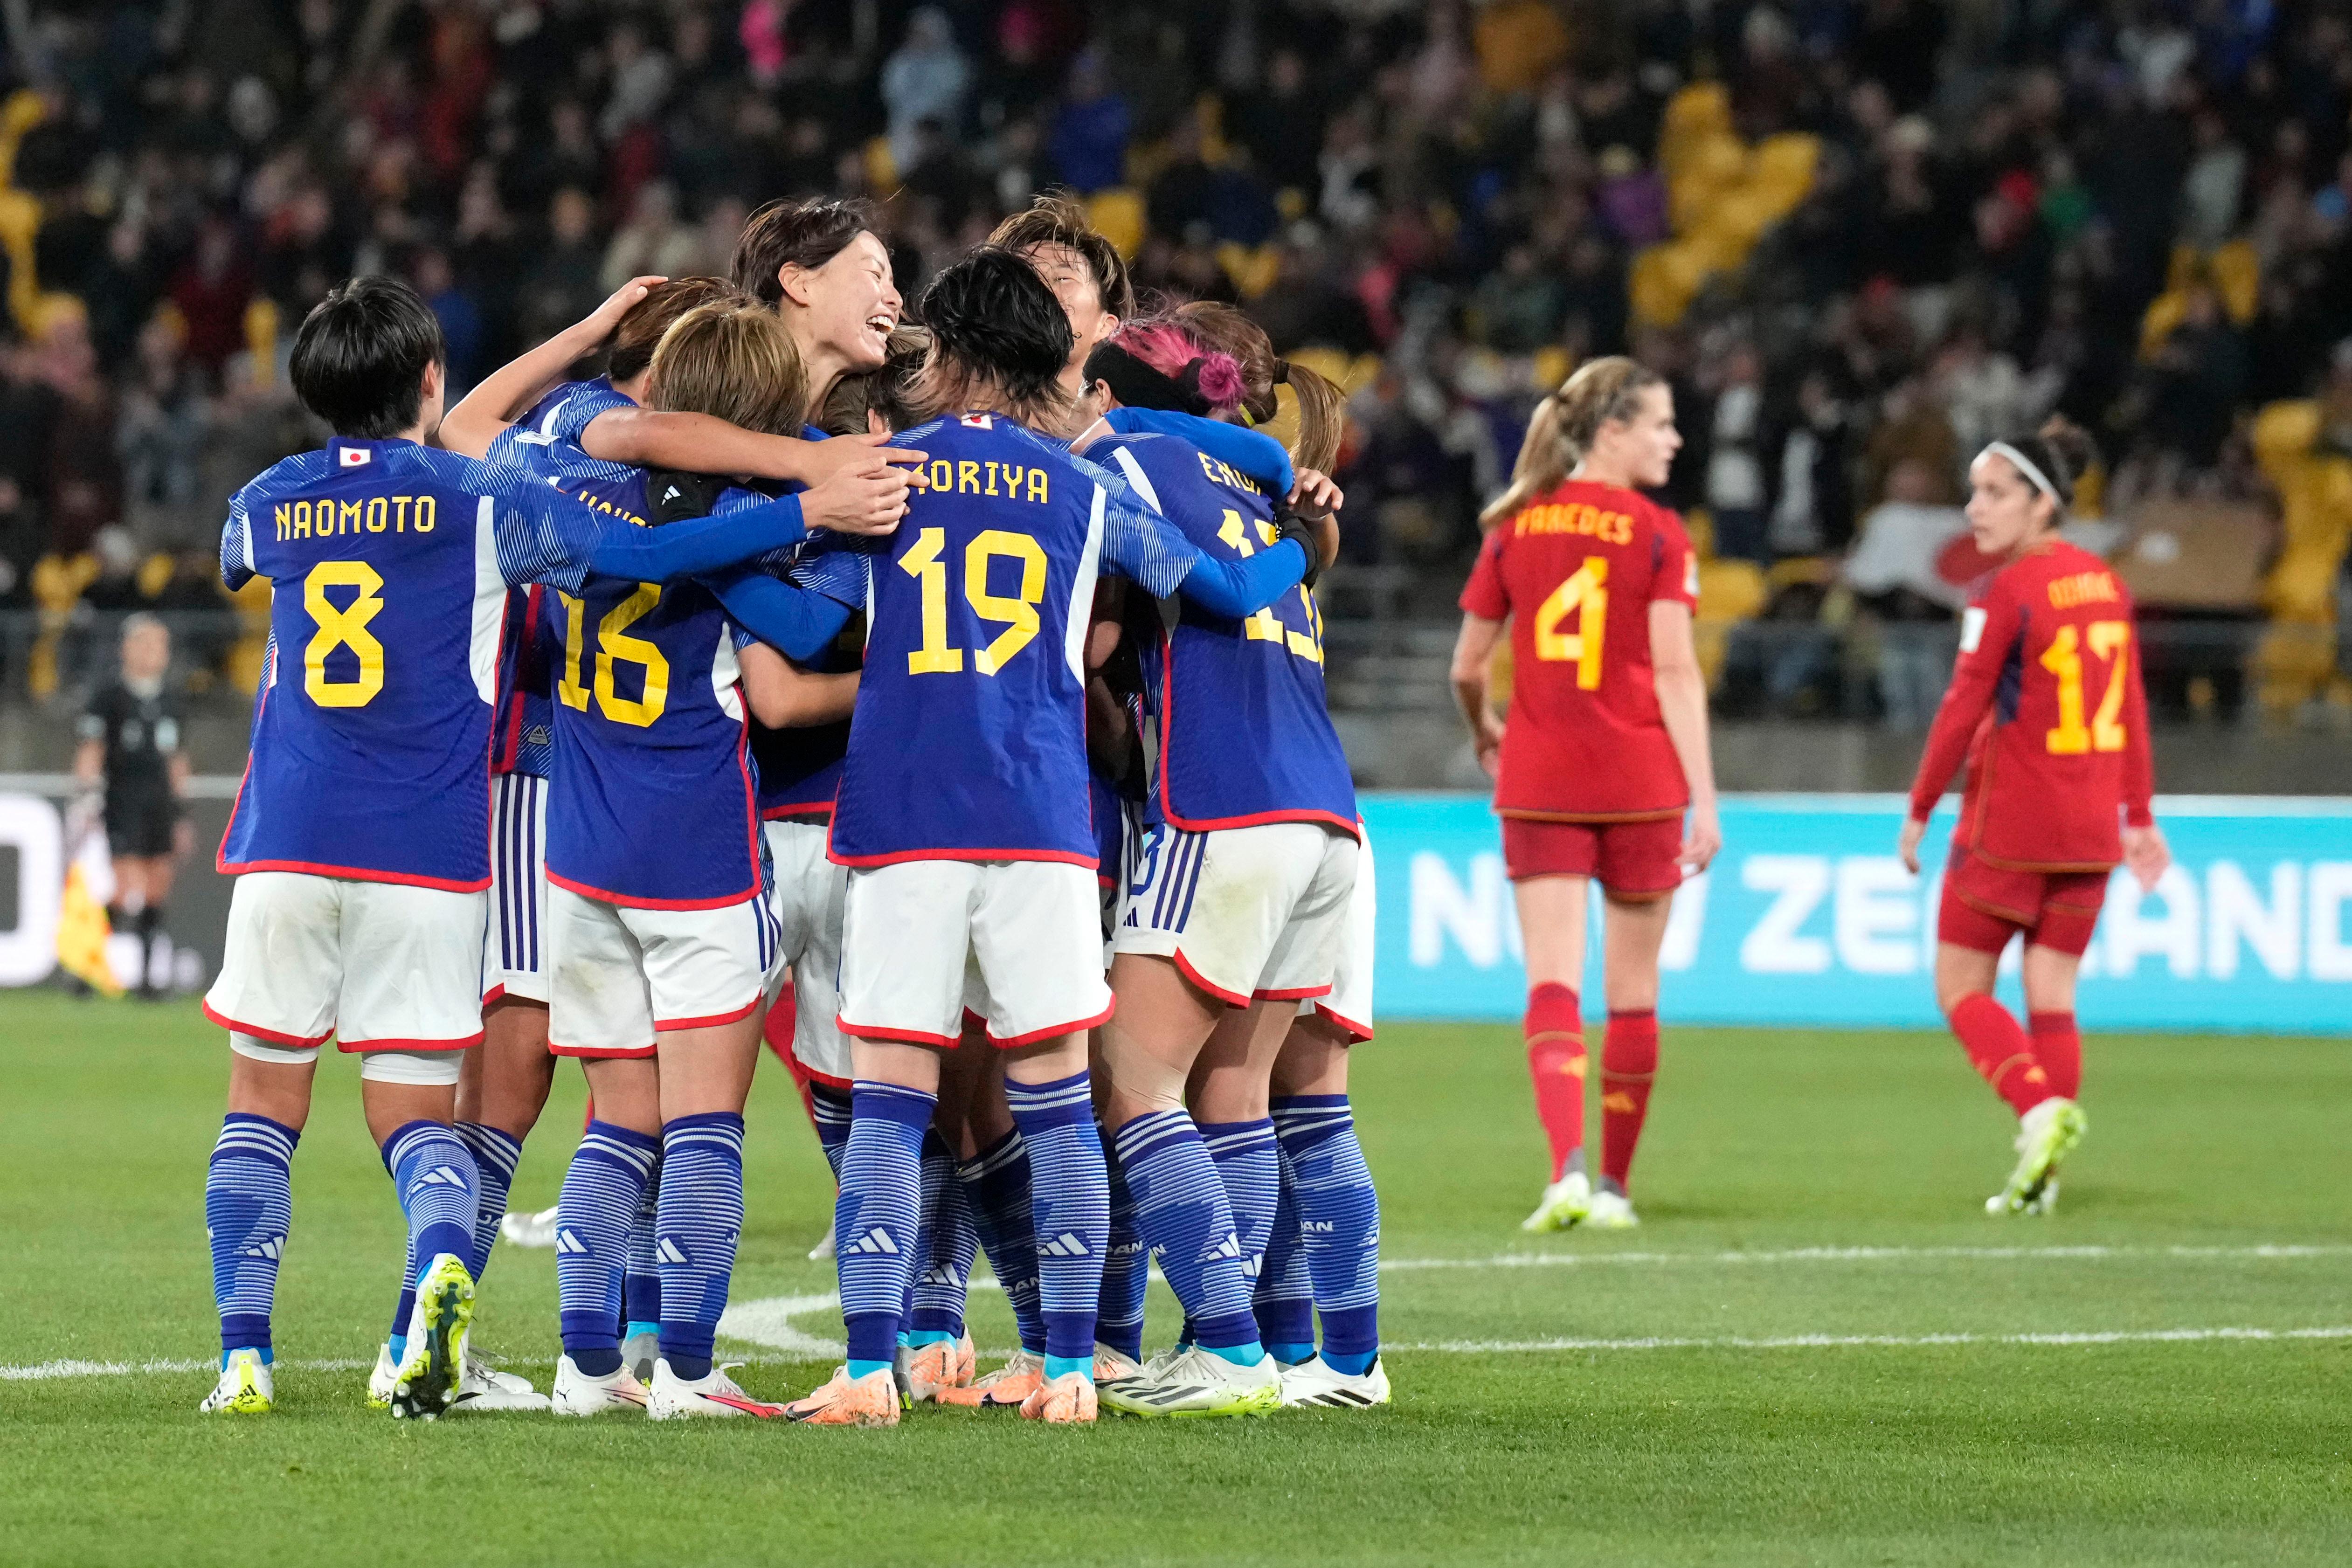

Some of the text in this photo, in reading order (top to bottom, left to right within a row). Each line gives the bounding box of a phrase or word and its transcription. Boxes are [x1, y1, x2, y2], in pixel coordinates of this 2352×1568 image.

[275, 495, 436, 542] NAOMOTO
[304, 560, 384, 708] 8
[558, 582, 670, 728] 16
[898, 527, 1048, 677] 19
[1535, 556, 1609, 691] 4
